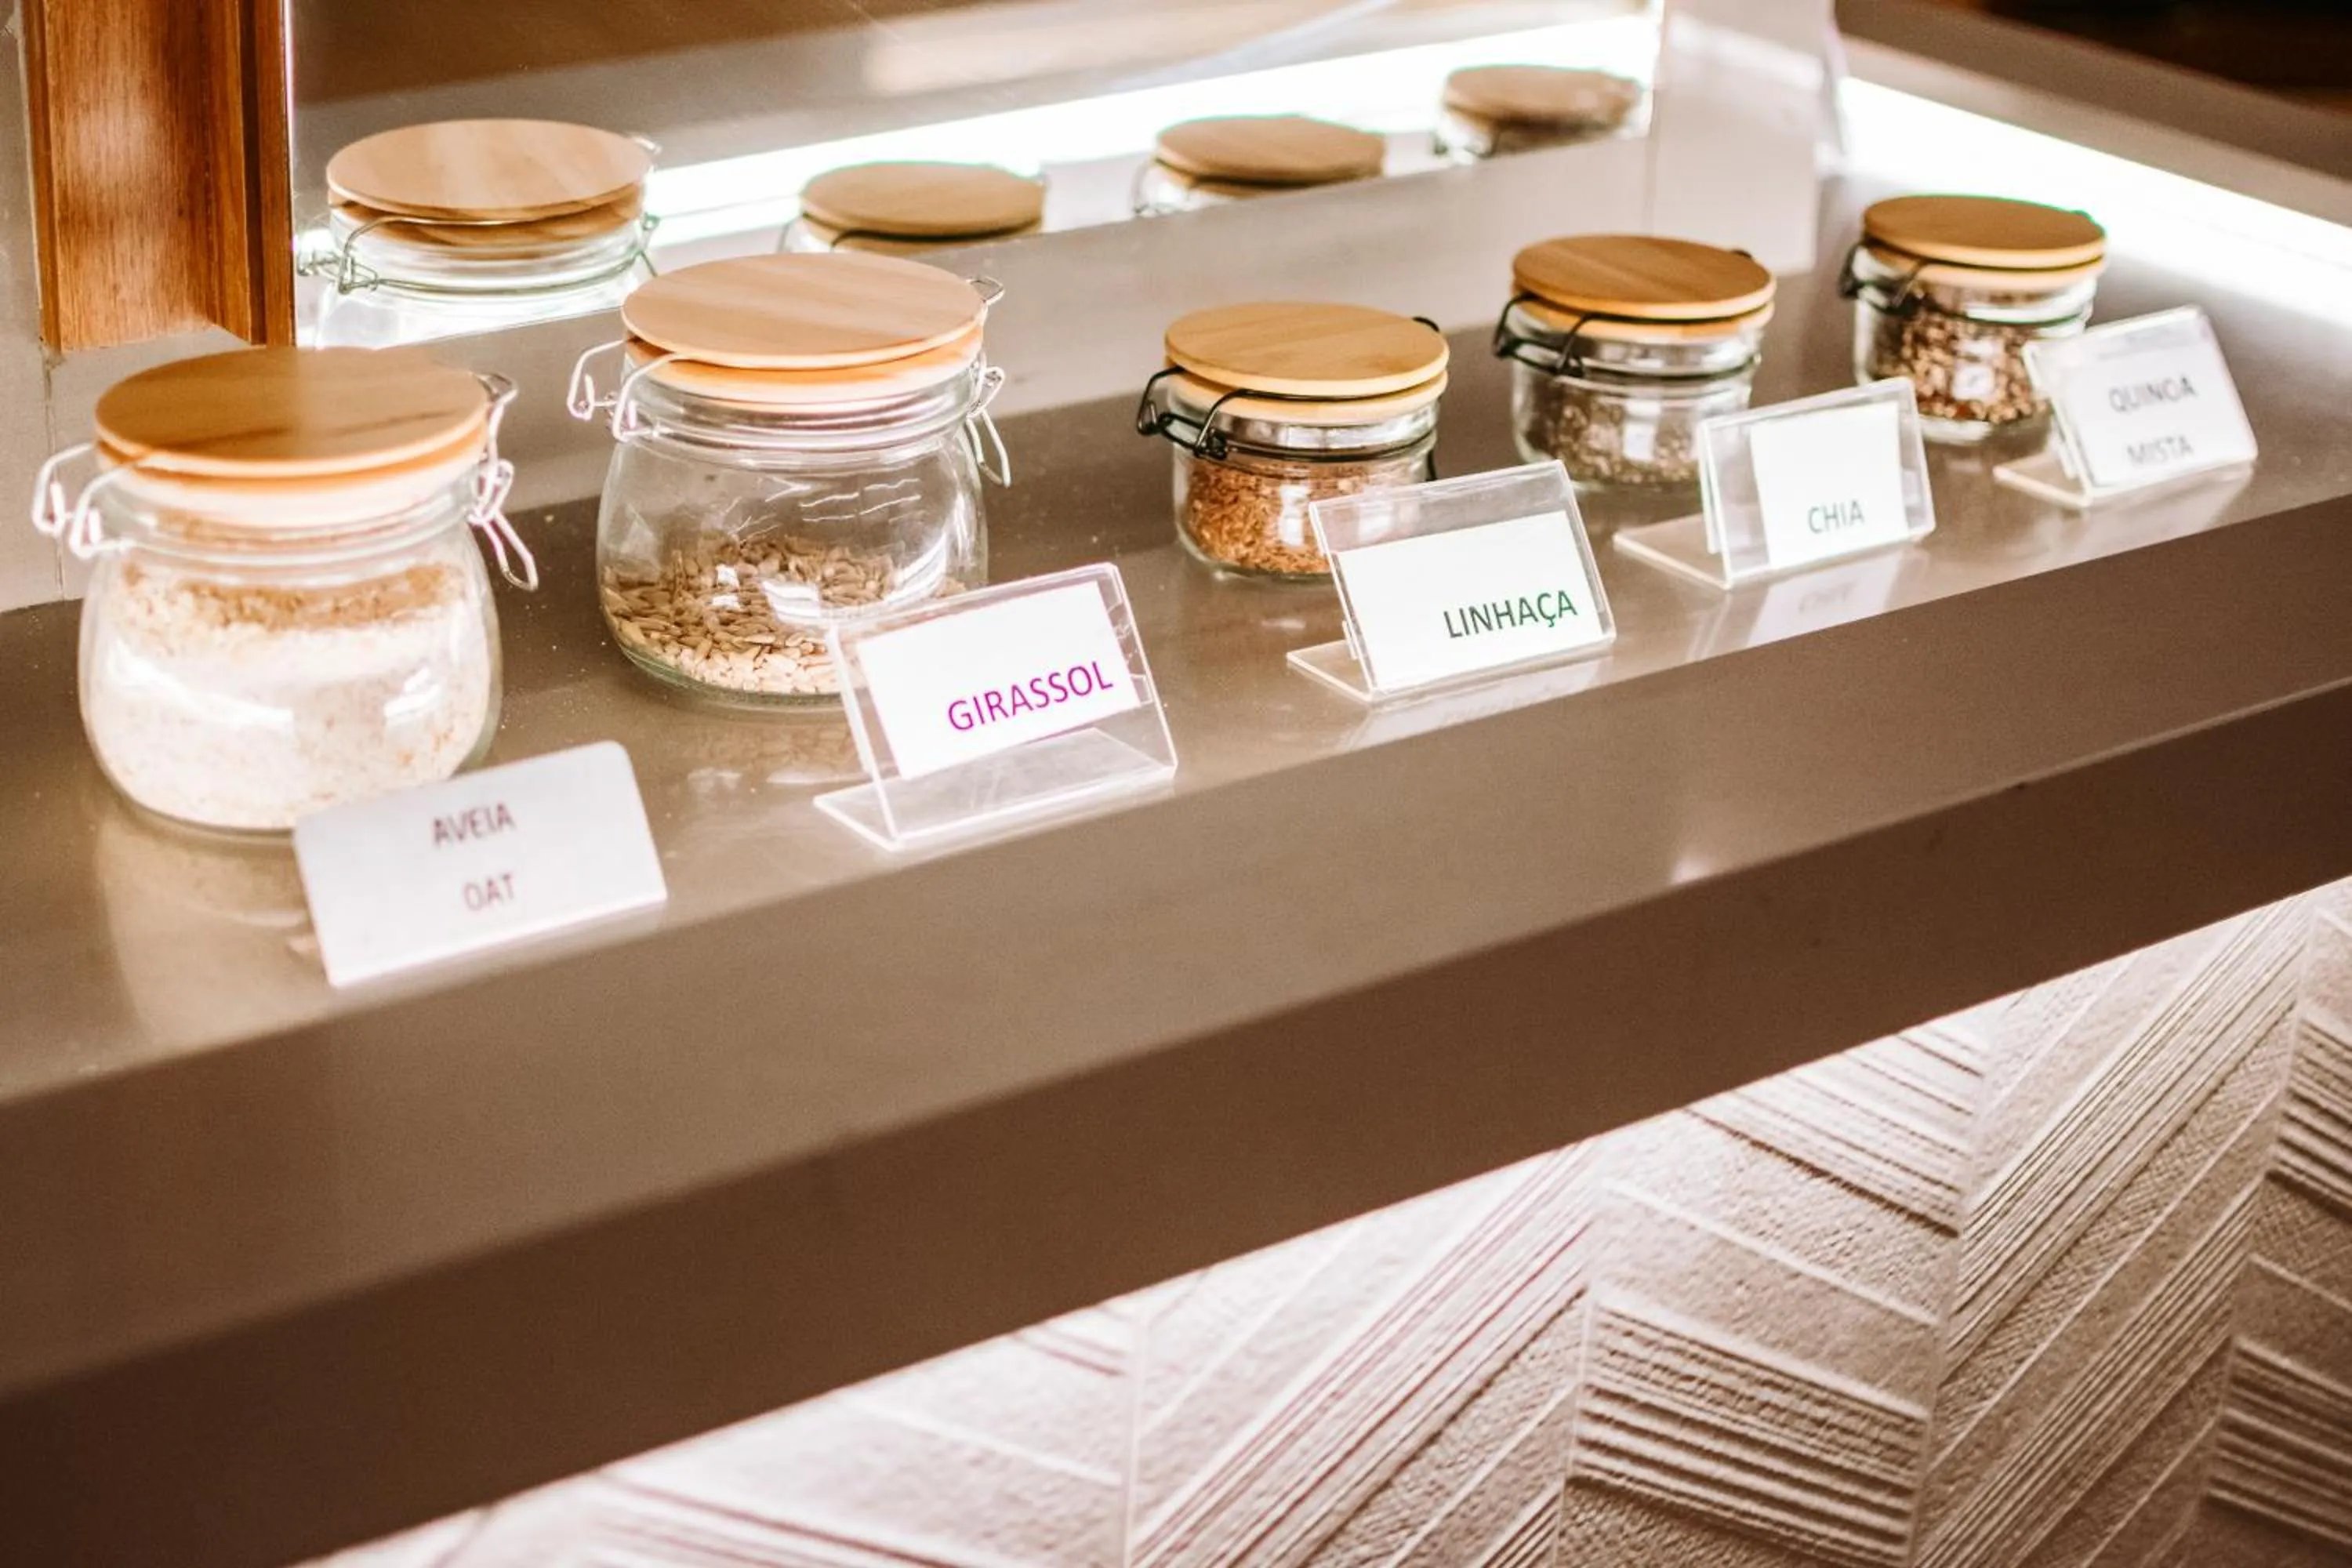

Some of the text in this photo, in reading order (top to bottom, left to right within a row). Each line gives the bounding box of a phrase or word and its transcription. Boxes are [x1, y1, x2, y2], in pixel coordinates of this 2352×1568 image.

[2109, 374, 2197, 412] QUINOA
[1807, 499, 1865, 534] CHIA
[1443, 590, 1578, 638] LINHAÇA
[948, 661, 1113, 731] GIRASSOL
[433, 802, 516, 847] AVEIA
[463, 873, 515, 912] OAT
